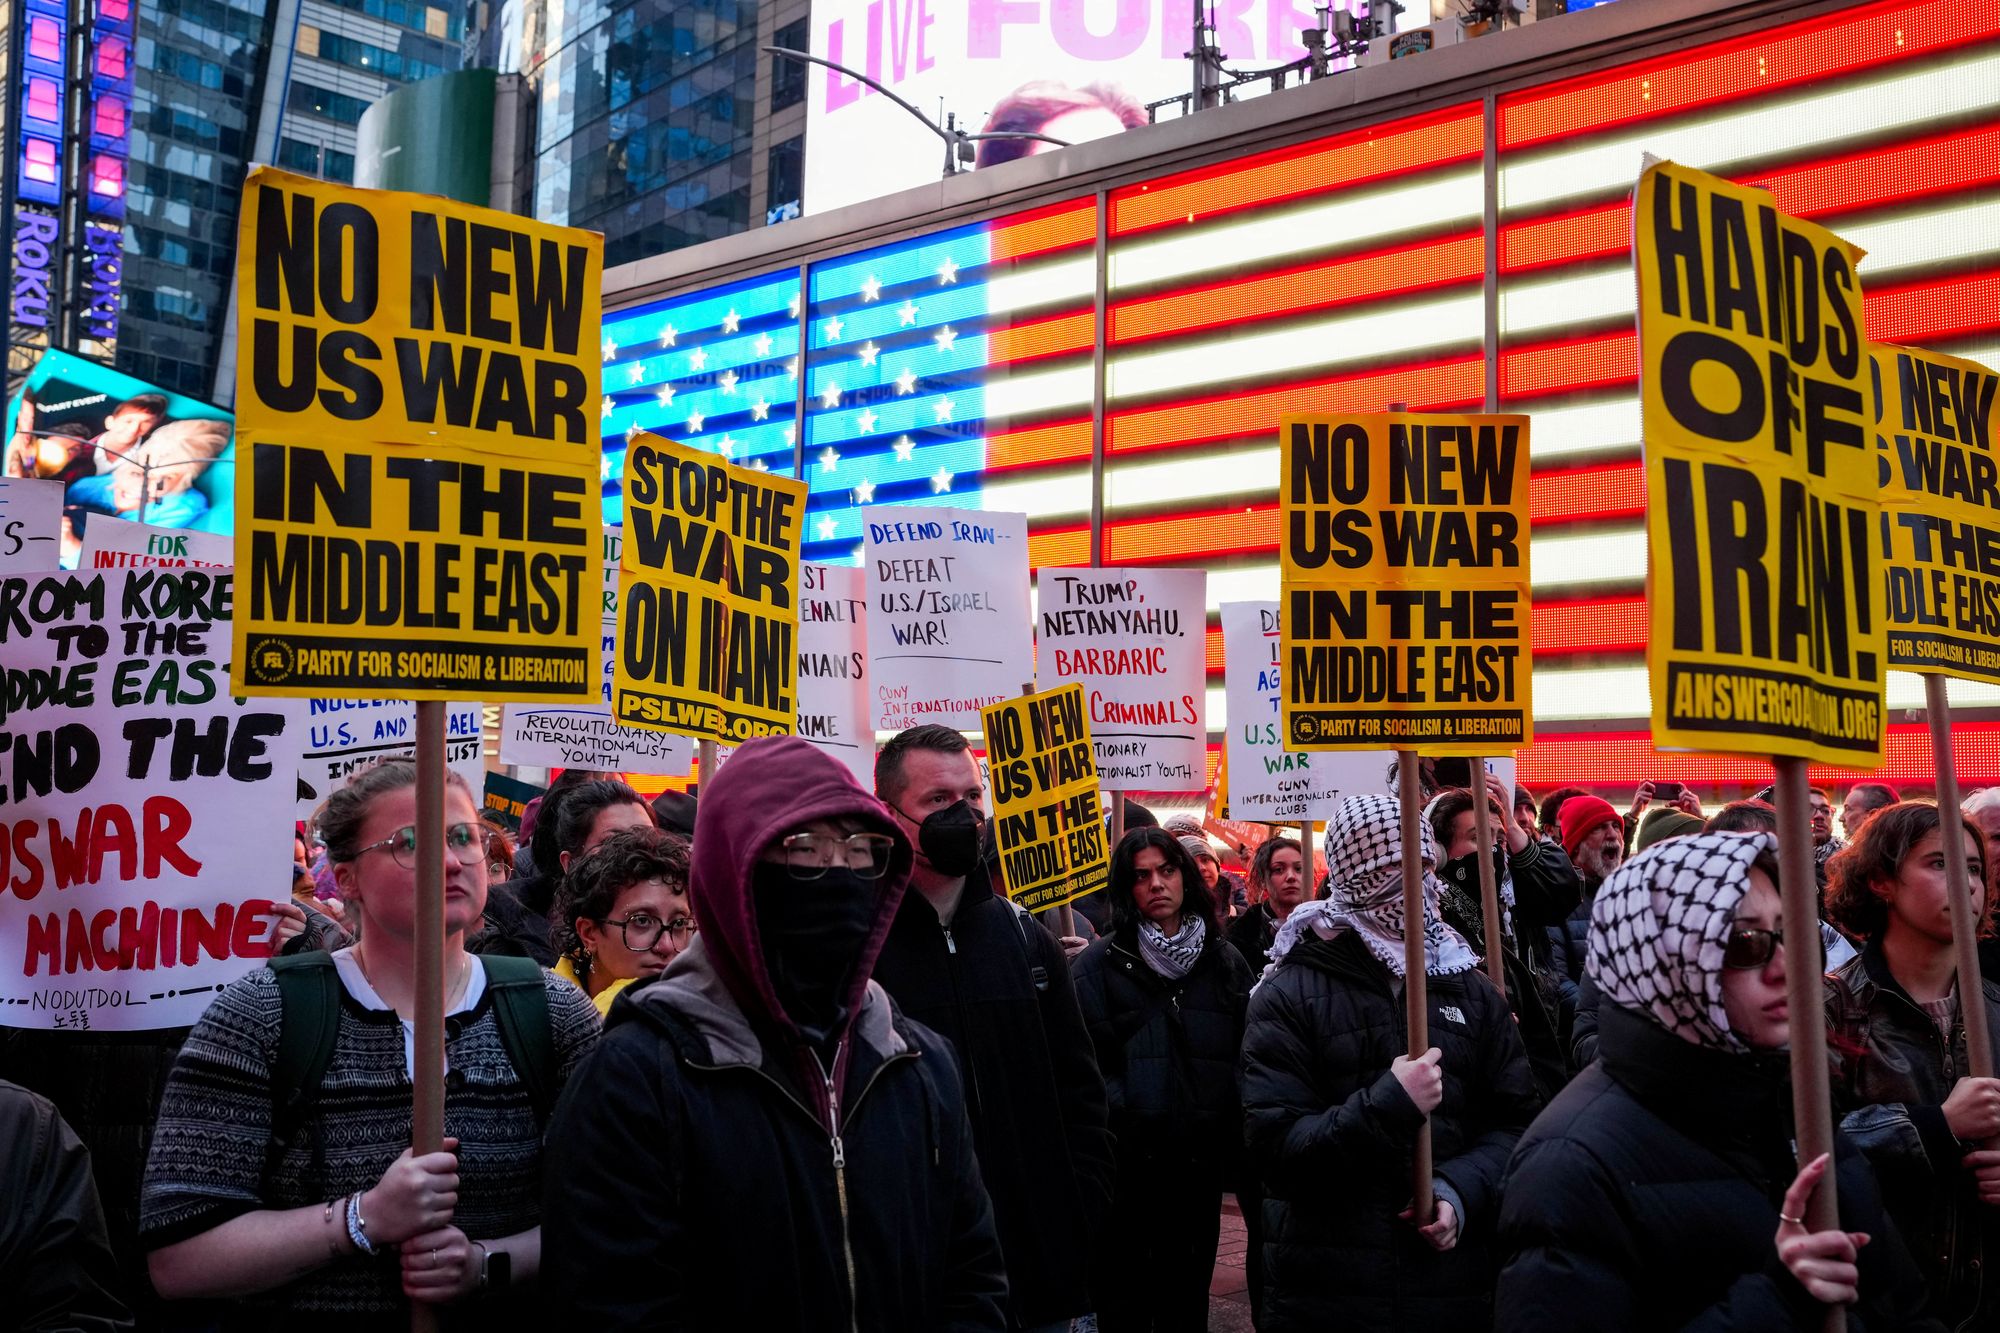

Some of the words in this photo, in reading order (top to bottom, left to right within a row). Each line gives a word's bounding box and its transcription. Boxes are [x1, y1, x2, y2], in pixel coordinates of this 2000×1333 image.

[826, 0, 935, 114] LIVE
[16, 211, 59, 326] Roku
[255, 185, 379, 324] NO
[410, 210, 588, 356] NEW
[253, 318, 383, 420] US
[394, 338, 587, 444] WAR
[1897, 353, 1998, 450] NEW
[1660, 331, 1864, 478] OFF
[1291, 423, 1369, 505] NO
[1389, 424, 1519, 506] NEW
[1895, 434, 2000, 511] WAR
[253, 442, 372, 529] IN
[386, 456, 586, 546] THE
[630, 445, 728, 522] STOP
[728, 483, 795, 550] THE
[148, 534, 188, 557] FOR
[870, 522, 942, 545] DEFEND
[1290, 509, 1373, 569] US
[1379, 510, 1519, 568] WAR
[1897, 512, 2000, 578] THE
[630, 506, 790, 610] WAR
[877, 556, 955, 583] DEFEAT
[1663, 458, 1877, 683] IRAN!
[251, 530, 460, 629] MIDDLE
[473, 545, 586, 636] EAST
[1054, 577, 1145, 605] TRUMP,
[1884, 565, 1949, 627] DLE
[0, 572, 104, 643] ROM
[122, 569, 233, 622] KORE
[801, 598, 866, 624] ENALT
[1043, 608, 1184, 637] NETANYAHU.
[1291, 590, 1367, 640] IN
[1376, 590, 1518, 640] THE
[47, 624, 109, 661] TO
[120, 621, 212, 656] THE
[624, 582, 688, 687] ON
[891, 620, 949, 646] WAR!
[1891, 639, 1913, 657] FOR
[1916, 640, 1963, 662] SOCIALISM
[1965, 646, 1973, 663] &
[1973, 647, 2000, 669] LIBERA
[297, 648, 353, 676] PARTY
[358, 651, 392, 678] FOR
[397, 653, 480, 680] SOCIALISM
[484, 656, 496, 681] &
[500, 657, 584, 684] LIBERATION
[1055, 647, 1167, 676] BARBARIC
[1291, 646, 1425, 703] MIDDLE
[1435, 645, 1519, 702] EAST
[879, 685, 908, 700] CUNY
[883, 696, 1006, 716] INTERNATIONALIST
[1090, 690, 1198, 726] CRIMINALS
[1673, 671, 1877, 741] ANSWERCOATION.ORG
[311, 722, 357, 748] U.S.
[374, 716, 407, 740] AND
[516, 730, 673, 759] INTERNATIONALIST
[527, 715, 667, 745] REVOLUTIONARY
[881, 716, 918, 729] CLUBS
[986, 707, 1023, 765] NO
[1029, 689, 1084, 753] NEW
[1320, 719, 1356, 736] PARTY
[1359, 719, 1380, 736] FOR
[1383, 718, 1441, 736] SOCIALISM
[1444, 718, 1453, 735] &
[1456, 718, 1521, 735] LIBERATION
[122, 713, 286, 782] THE
[561, 748, 620, 768] YOUTH
[1092, 742, 1147, 757] TIONARY
[1264, 752, 1310, 775] WAR
[992, 760, 1032, 804] US
[1032, 743, 1092, 793] WAR
[1278, 778, 1310, 791] CUNY
[486, 793, 510, 812] STOP
[1242, 790, 1339, 805] INTERNATIONALIST
[1275, 804, 1307, 816] CLUBS
[48, 796, 202, 890] WAR
[998, 810, 1038, 851] IN
[1038, 790, 1099, 837] THE
[1004, 836, 1067, 891] MIDDLE
[1070, 823, 1103, 868] EAST
[1024, 892, 1041, 906] PARTY
[1042, 889, 1054, 900] FOR
[23, 899, 277, 977] MACHINE
[33, 989, 147, 1011] NODUTDOL
